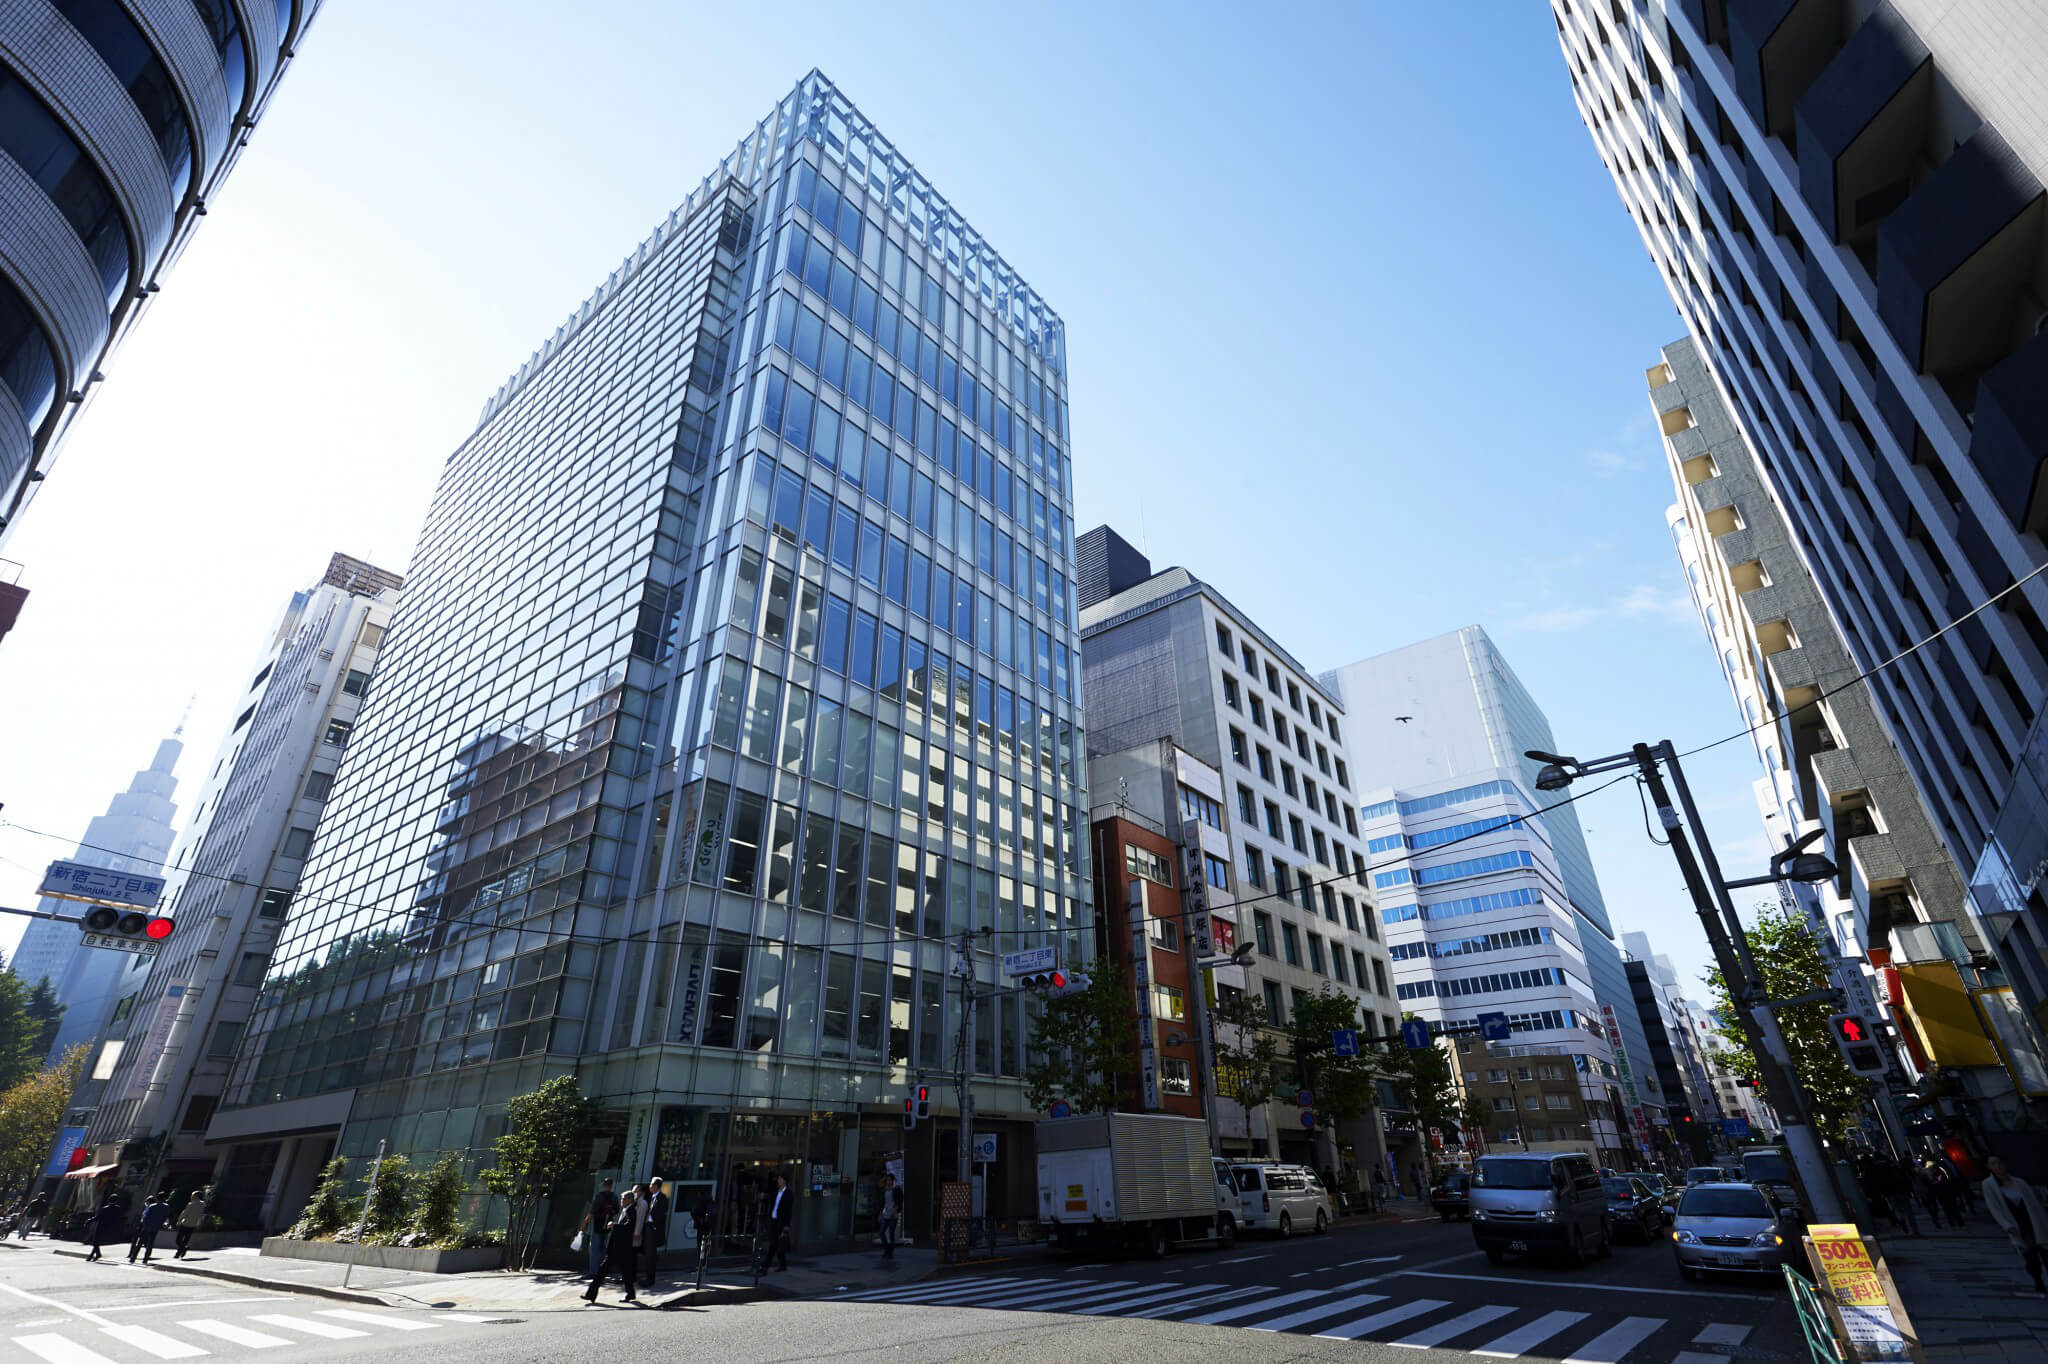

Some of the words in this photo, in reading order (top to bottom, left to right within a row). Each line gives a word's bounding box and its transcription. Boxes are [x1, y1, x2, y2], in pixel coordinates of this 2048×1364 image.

[51, 866, 160, 896] 新宿二丁目東
[72, 883, 112, 897] Shinjuku
[85, 935, 157, 953] 自転車専用
[680, 964, 700, 1041] LIVEMAX
